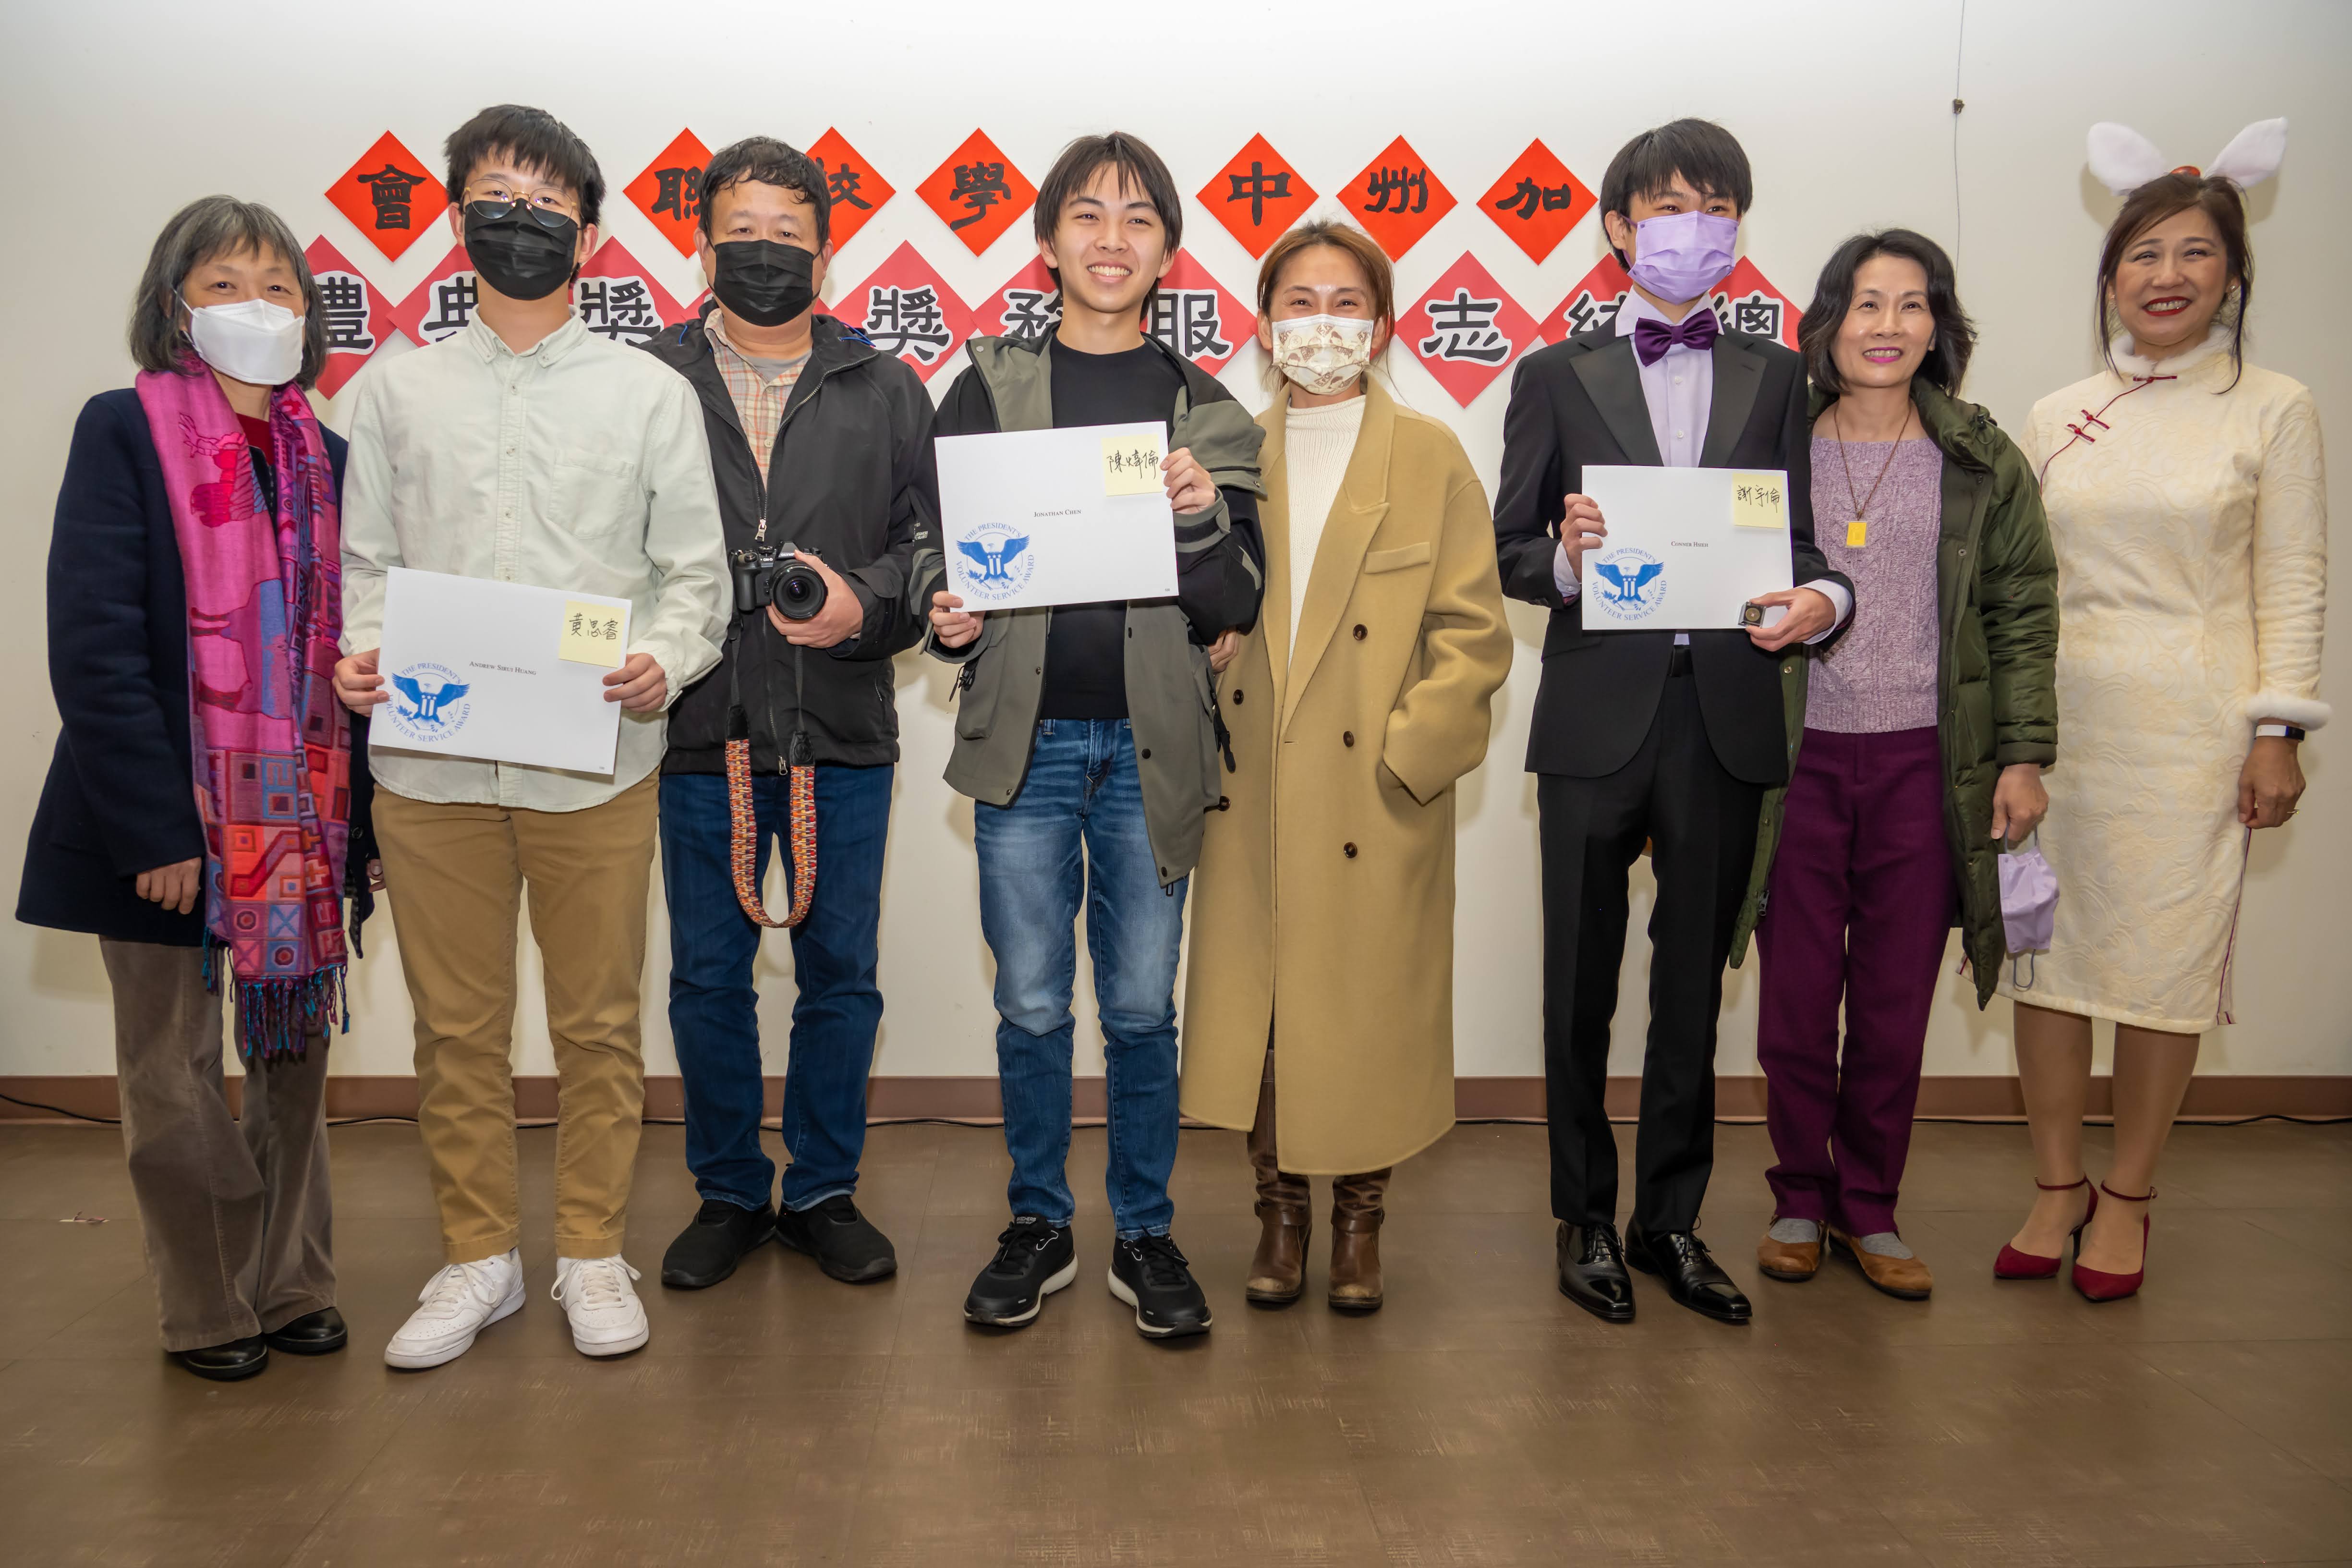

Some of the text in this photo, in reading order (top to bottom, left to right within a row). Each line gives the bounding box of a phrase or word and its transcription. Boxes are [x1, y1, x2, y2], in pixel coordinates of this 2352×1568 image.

[357, 164, 427, 230] 會
[950, 161, 1011, 231] 學
[1227, 161, 1293, 226] 中
[1364, 166, 1429, 214] 州
[1495, 176, 1571, 220] 加
[869, 288, 950, 361] 獎
[1151, 293, 1229, 357] 服
[1421, 292, 1508, 360] 志
[1737, 485, 1780, 513] 謝宇倫
[964, 523, 1022, 541] THE PRESIDENT'S
[956, 555, 1034, 600] VOLUNTEER SERVICE AWARD
[1602, 547, 1656, 564] THE PRESIDENT'S
[1592, 580, 1666, 620] VOLUNTEER SERVICE AWARD
[401, 663, 462, 684] THE PRESIDENT'S
[418, 729, 454, 742] SERVICE
[454, 703, 471, 732] AWARD
